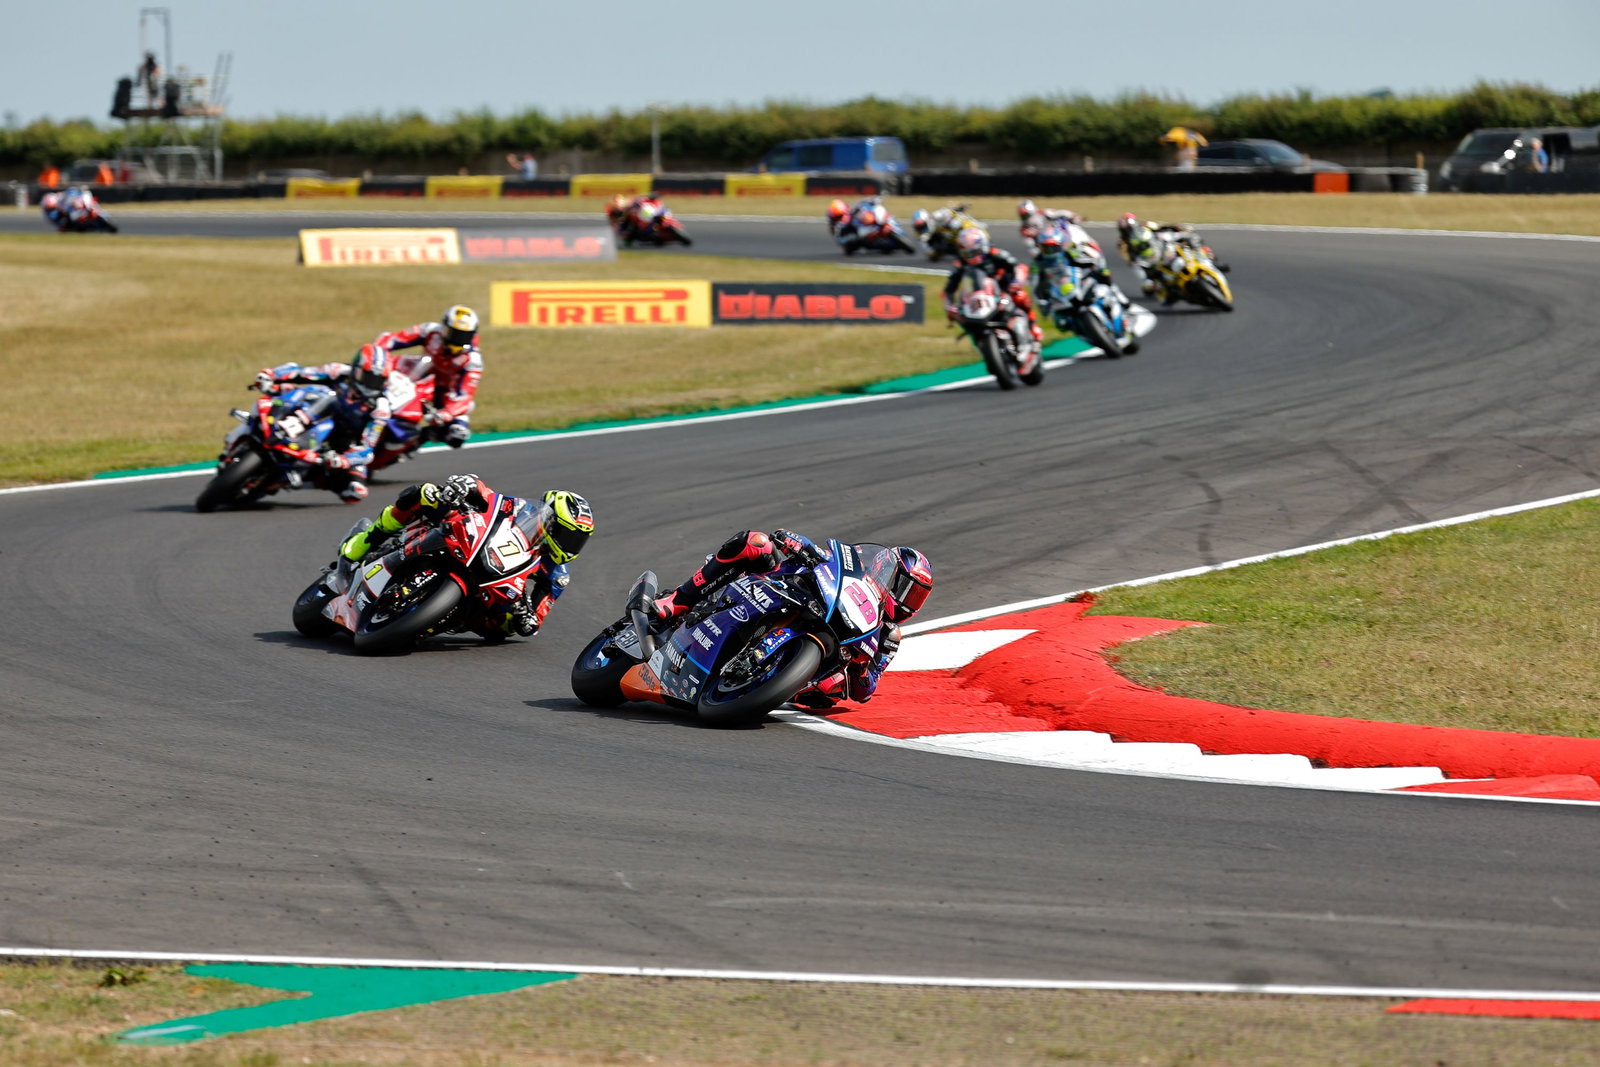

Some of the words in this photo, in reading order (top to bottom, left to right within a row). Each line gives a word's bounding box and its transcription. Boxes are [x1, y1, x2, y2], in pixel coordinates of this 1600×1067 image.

[318, 237, 446, 262] PIRELLI
[511, 289, 693, 325] PIRELLI
[719, 291, 904, 320] DIABLO
[497, 540, 520, 557] 1
[364, 563, 383, 580] 1
